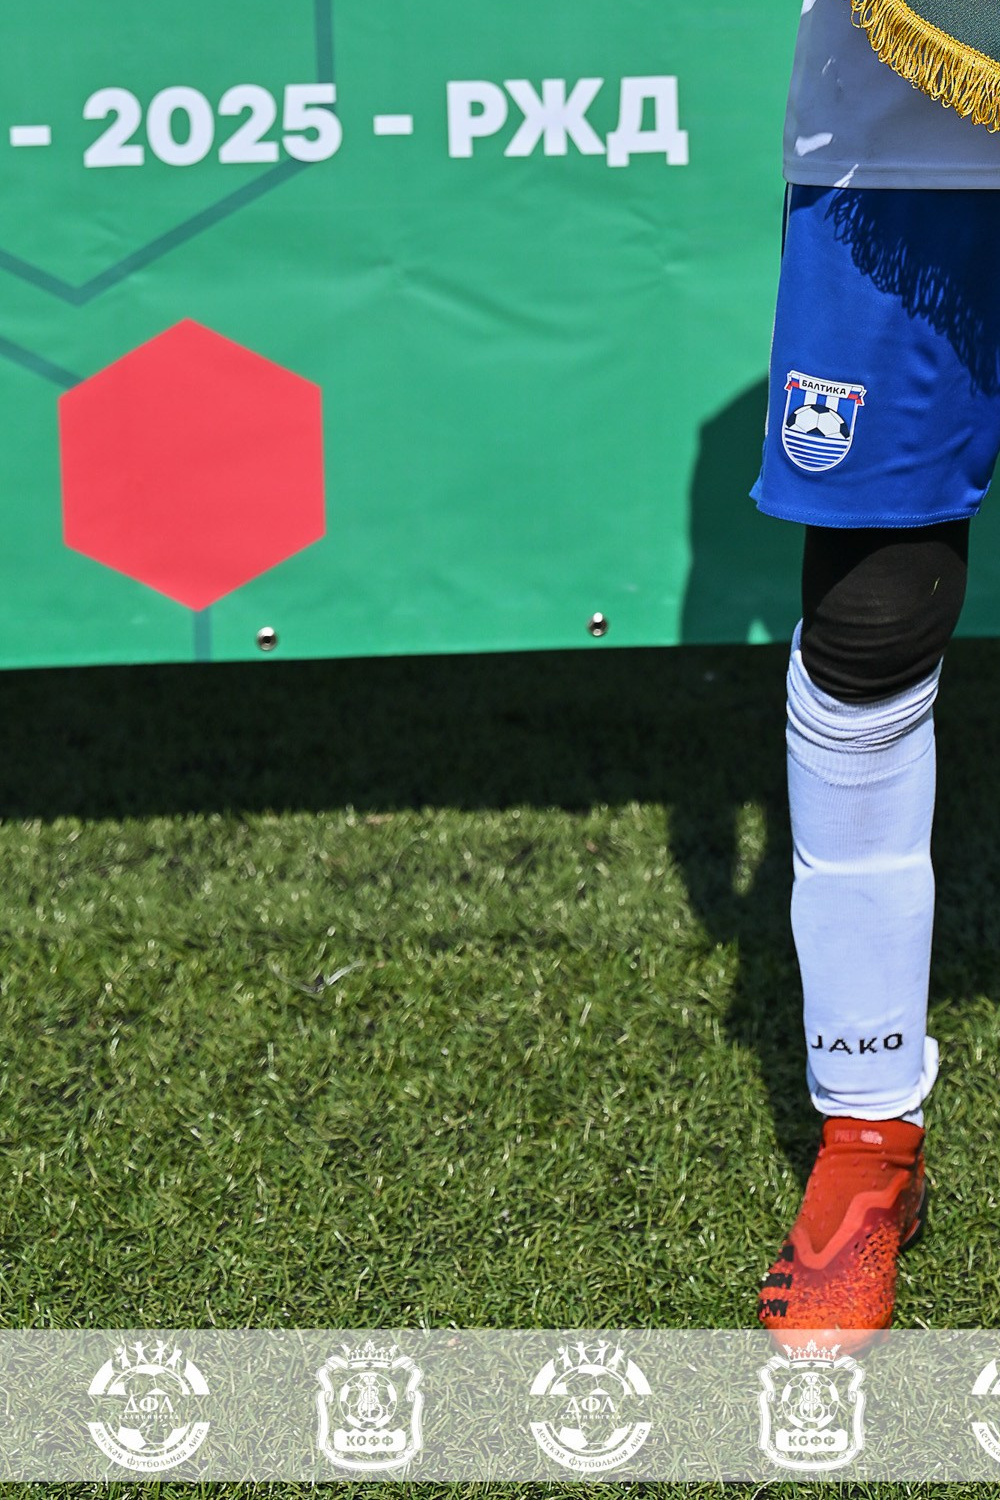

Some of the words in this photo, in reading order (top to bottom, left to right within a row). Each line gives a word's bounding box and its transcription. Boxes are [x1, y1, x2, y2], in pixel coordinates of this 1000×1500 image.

[83, 84, 342, 167] 2025
[446, 76, 688, 167] РЖД
[801, 380, 847, 395] БАЛТИКА
[811, 1033, 903, 1055] JAKO
